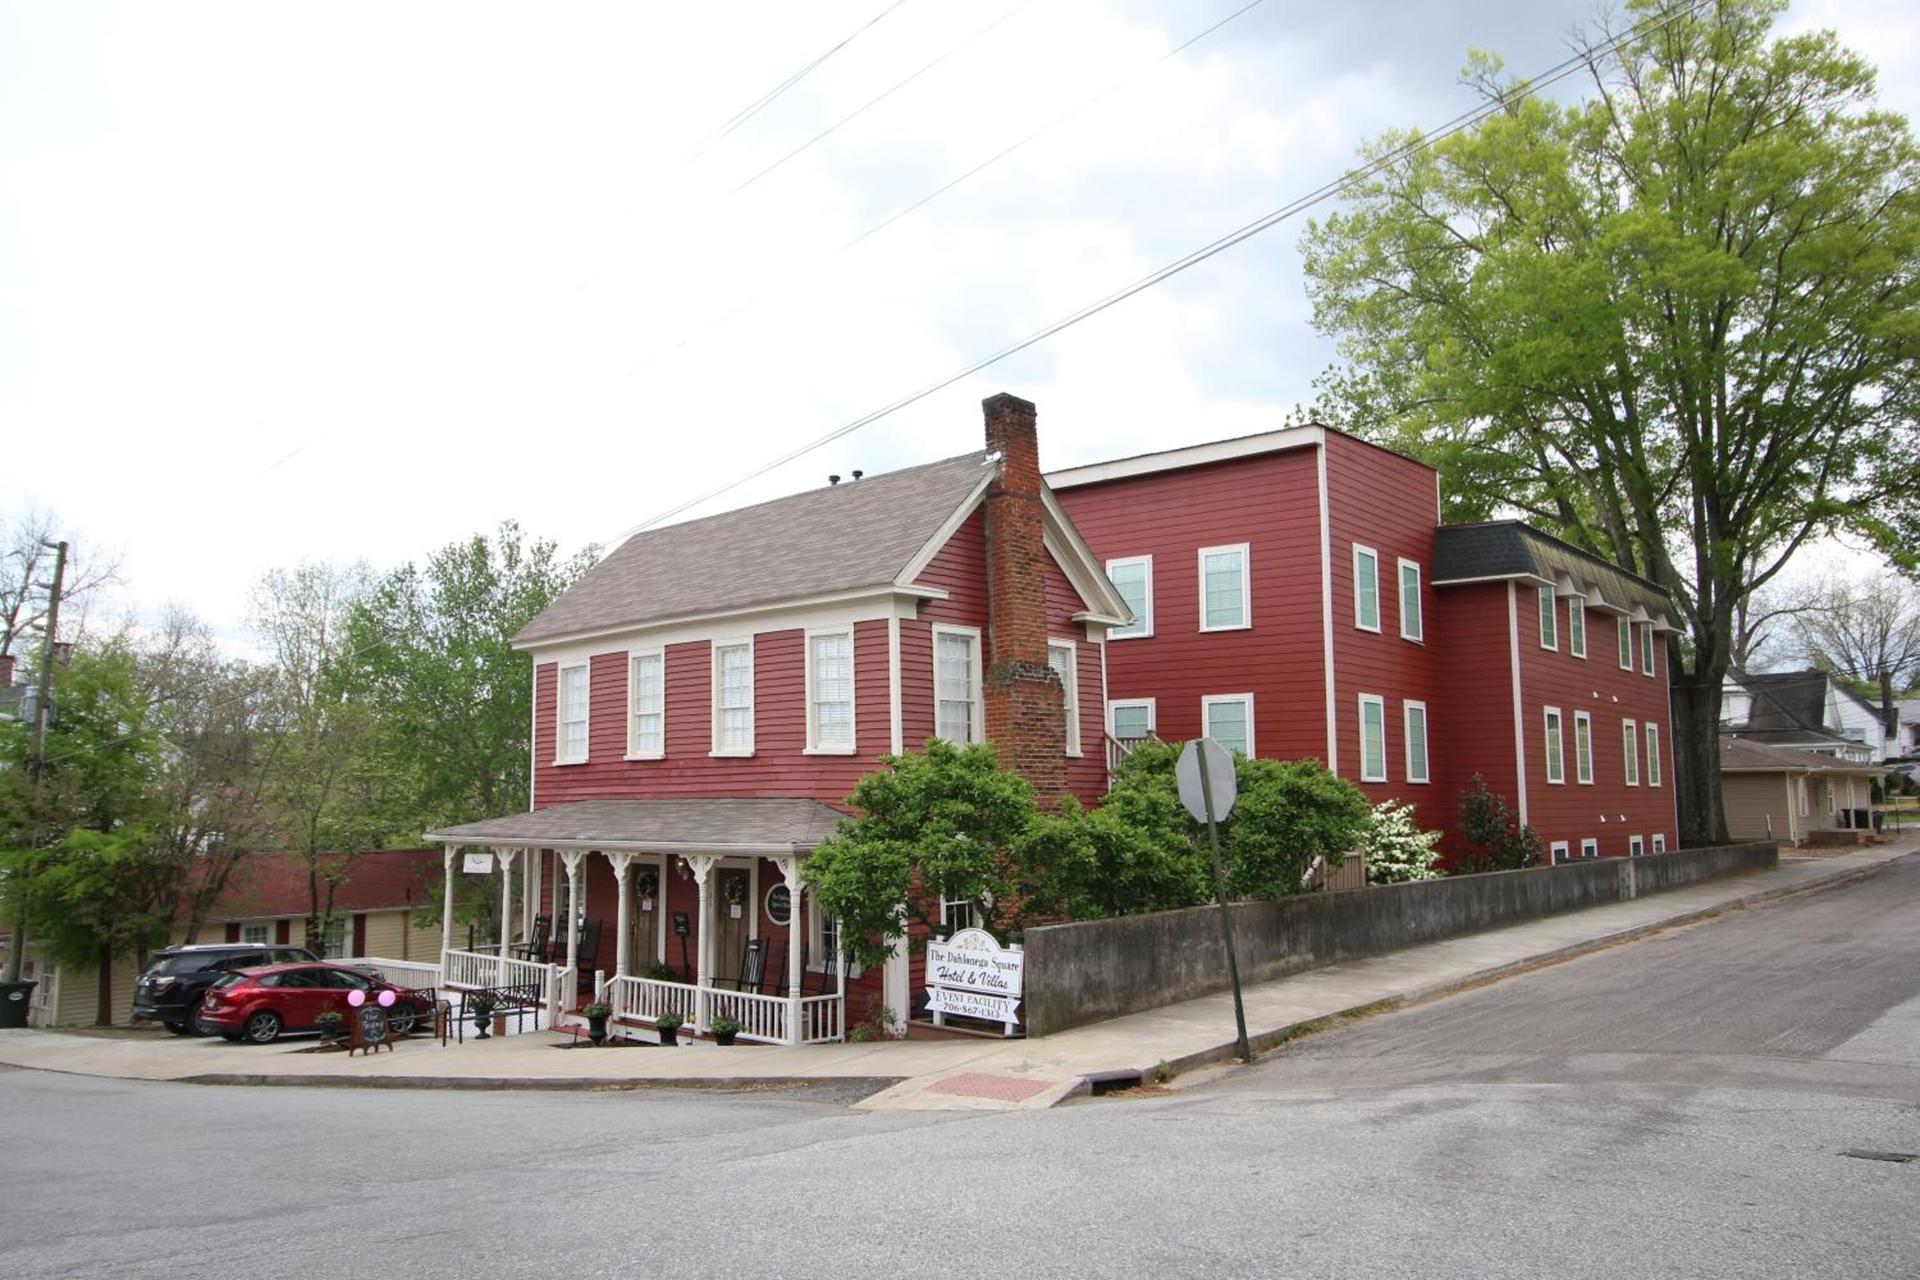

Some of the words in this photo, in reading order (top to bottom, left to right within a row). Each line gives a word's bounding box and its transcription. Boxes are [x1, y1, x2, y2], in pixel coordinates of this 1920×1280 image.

[931, 950, 945, 962] The
[947, 951, 988, 969] Dahlonega
[991, 957, 1020, 973] Square
[937, 966, 965, 983] Hotel
[967, 971, 977, 985] &
[978, 972, 1008, 989] Villas
[936, 990, 964, 1003] EVENT
[967, 994, 1011, 1013] FACILITY
